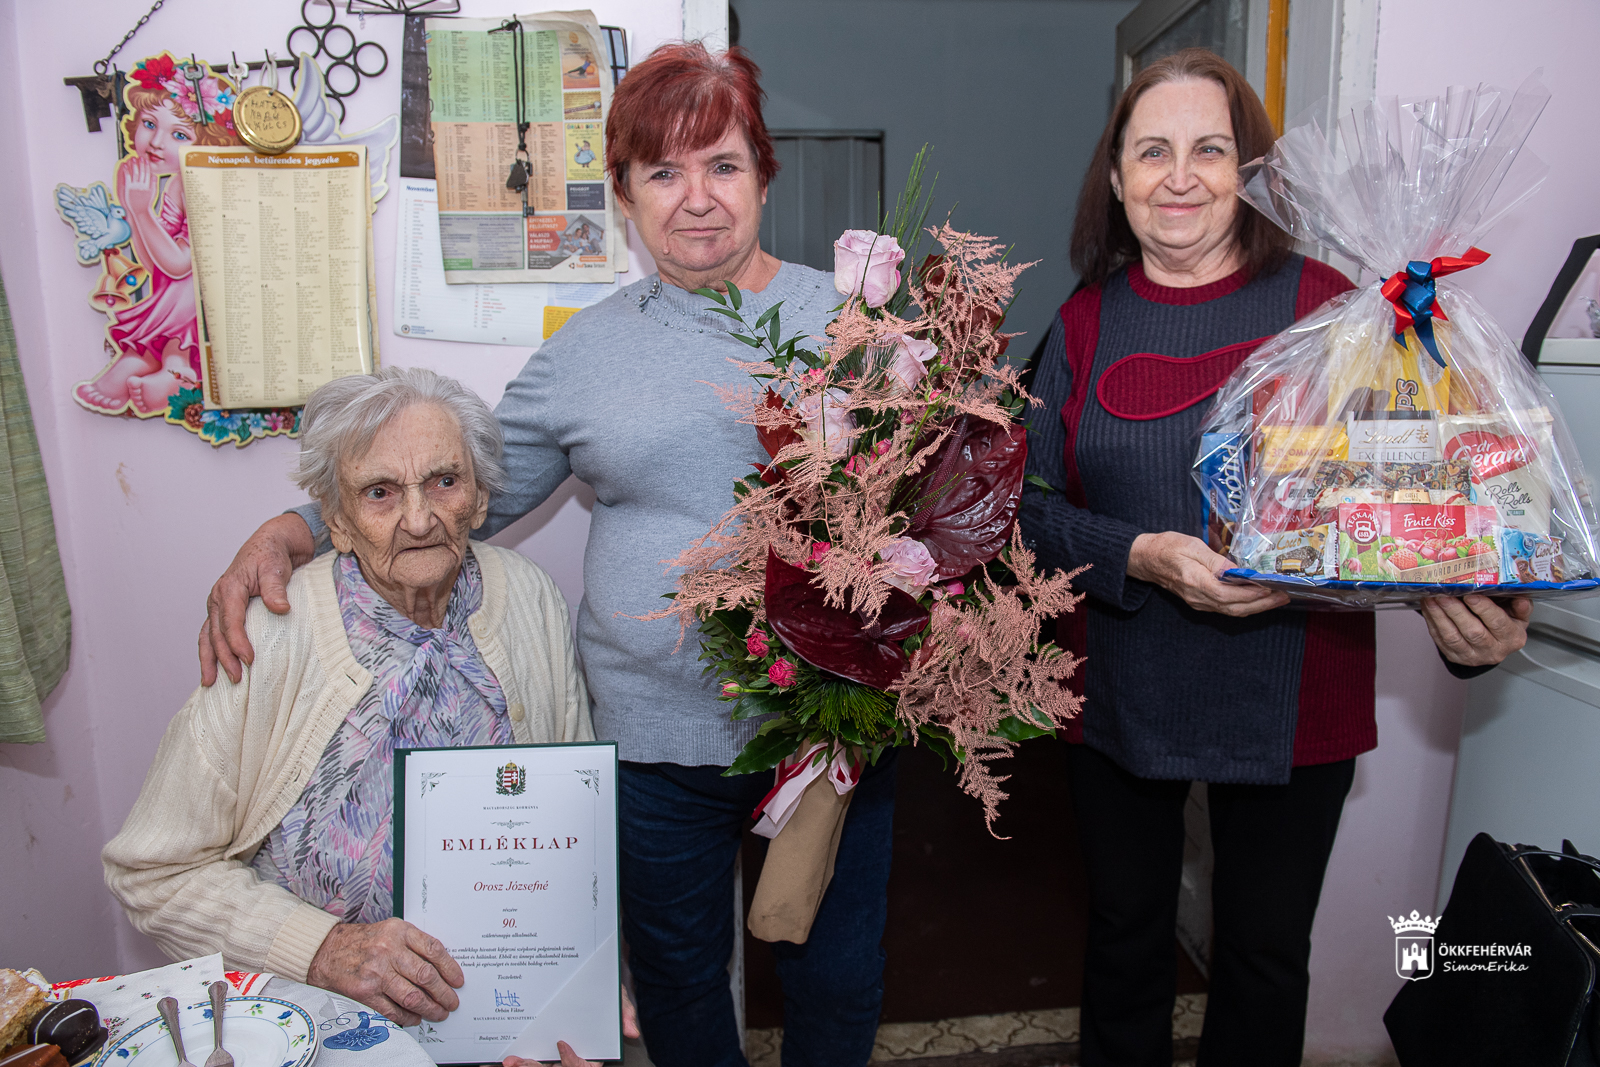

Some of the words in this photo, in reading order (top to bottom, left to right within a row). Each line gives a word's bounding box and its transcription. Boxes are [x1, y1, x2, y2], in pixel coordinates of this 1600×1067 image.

[208, 156, 250, 165] Névnapok
[254, 156, 301, 165] betűrendes
[406, 185, 435, 193] November
[1359, 427, 1415, 445] Lindt
[1477, 440, 1495, 452] dr
[1358, 451, 1428, 461] EXCELLENCE
[1485, 482, 1522, 498] Rolls
[1497, 492, 1533, 509] Rolls
[1404, 513, 1432, 527] Fruit
[1434, 513, 1456, 527] Kiss
[1427, 566, 1451, 578] WORLD
[1454, 563, 1461, 573] OF
[442, 835, 578, 851] EMLÉKLAP
[473, 881, 503, 892] Orosz
[505, 880, 549, 893] Józsefné
[502, 918, 518, 928] 90.
